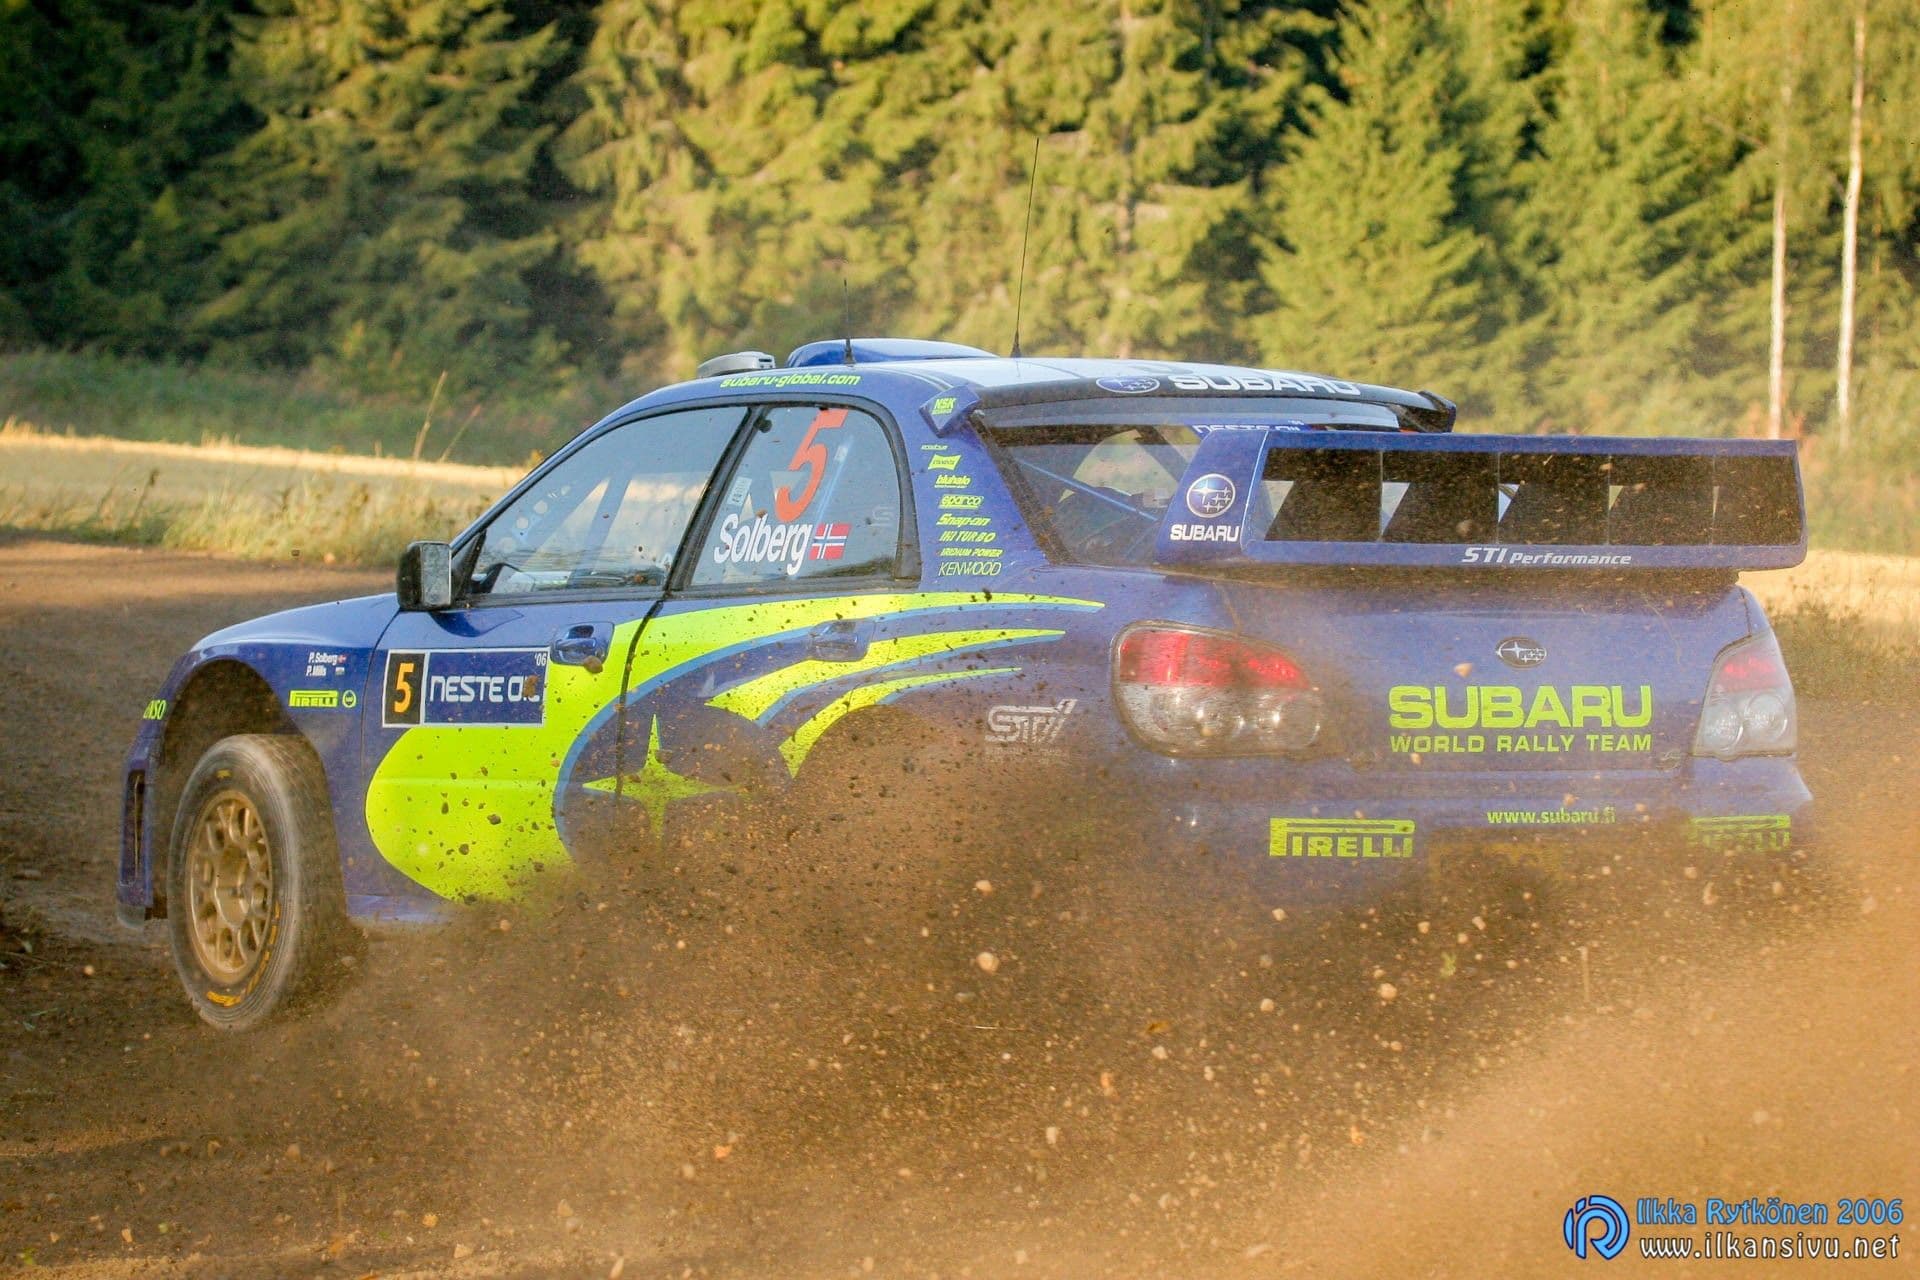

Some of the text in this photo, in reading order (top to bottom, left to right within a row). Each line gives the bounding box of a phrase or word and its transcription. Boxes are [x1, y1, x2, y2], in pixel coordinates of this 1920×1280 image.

[720, 372, 861, 388] subaru-global.com
[1168, 375, 1361, 396] SUBARU
[775, 409, 849, 522] 5
[955, 530, 996, 542] TURBO
[1170, 523, 1240, 542] SUBARU
[713, 513, 813, 576] Solberg
[1461, 547, 1632, 565] STI Performance
[938, 561, 1002, 577] KENWOOD
[394, 662, 415, 714] 5
[429, 675, 505, 703] NESTE
[288, 689, 338, 708] PIRELLI
[1389, 685, 1653, 729] SUBARU
[1389, 733, 1653, 753] WORLD RALLY TEAM
[1486, 806, 1616, 825] www.subaru.fi
[1269, 817, 1416, 858] PIRELLI
